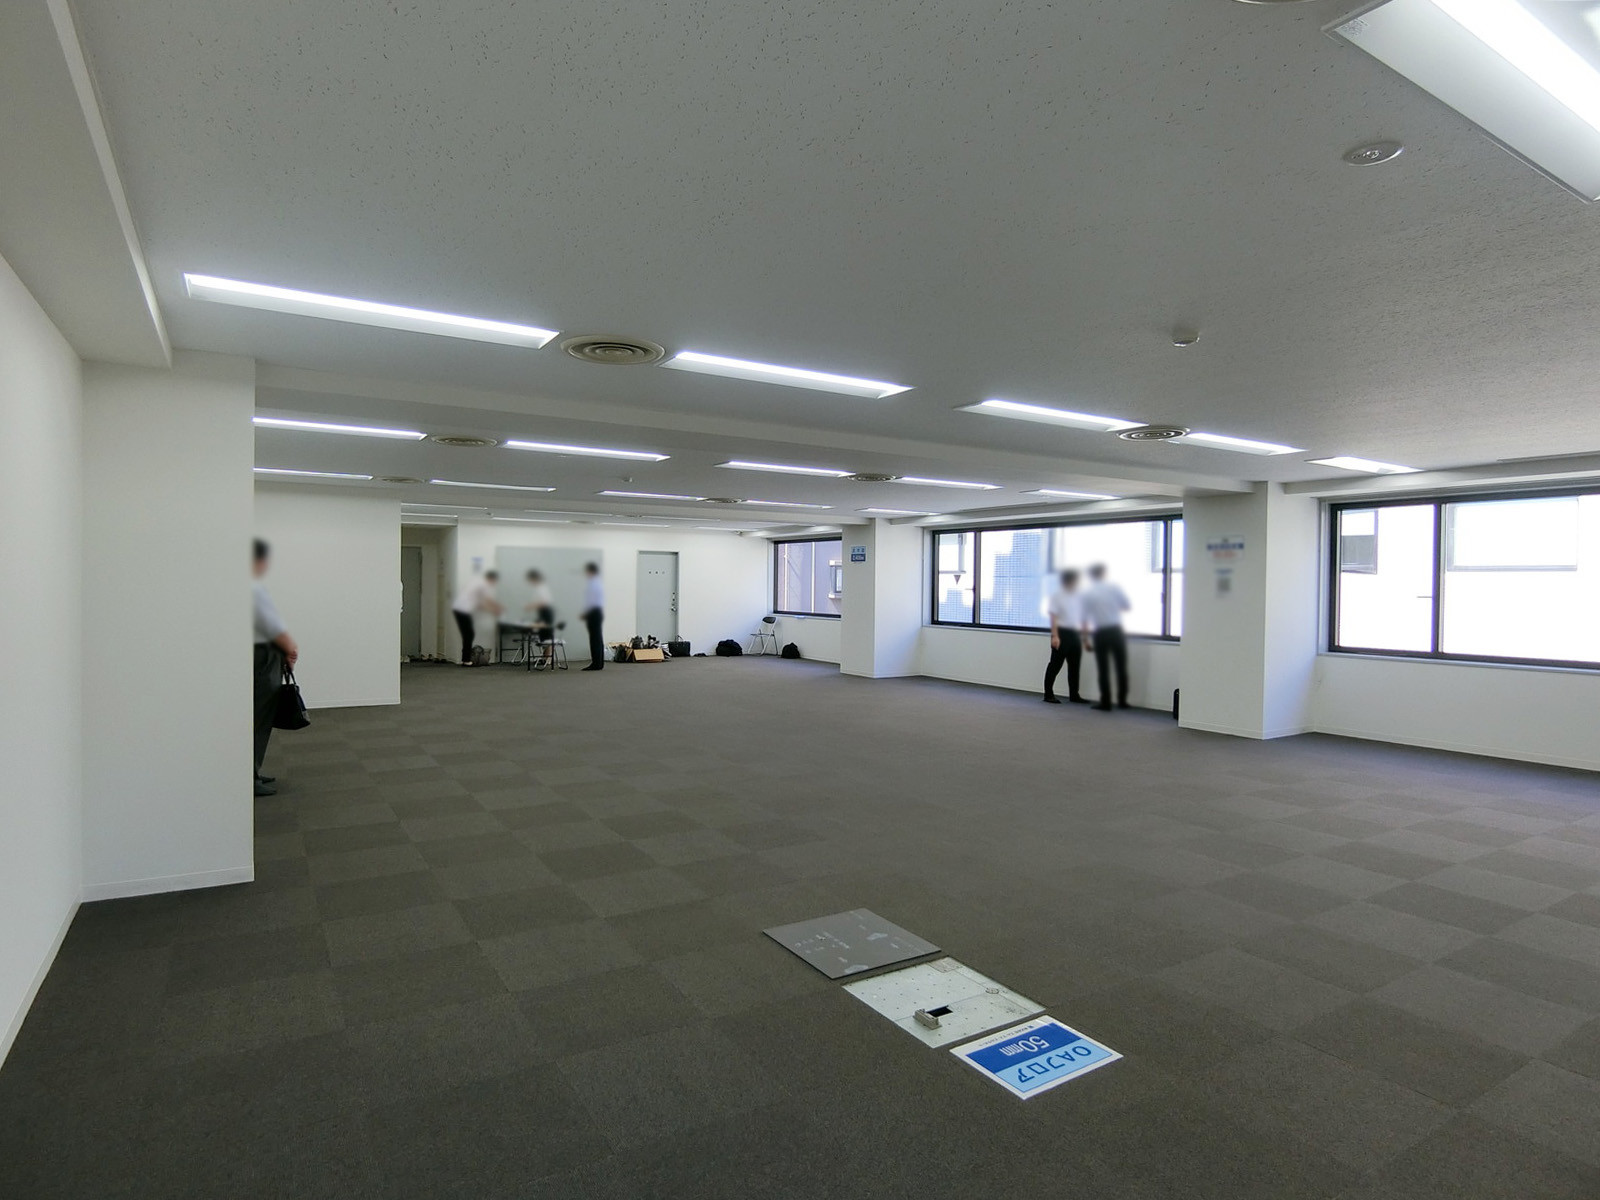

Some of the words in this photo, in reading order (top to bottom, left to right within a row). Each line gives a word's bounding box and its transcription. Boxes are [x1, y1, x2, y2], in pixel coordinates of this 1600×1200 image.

[999, 1035, 1051, 1056] 50mm
[1017, 1045, 1092, 1083] OAフロア
